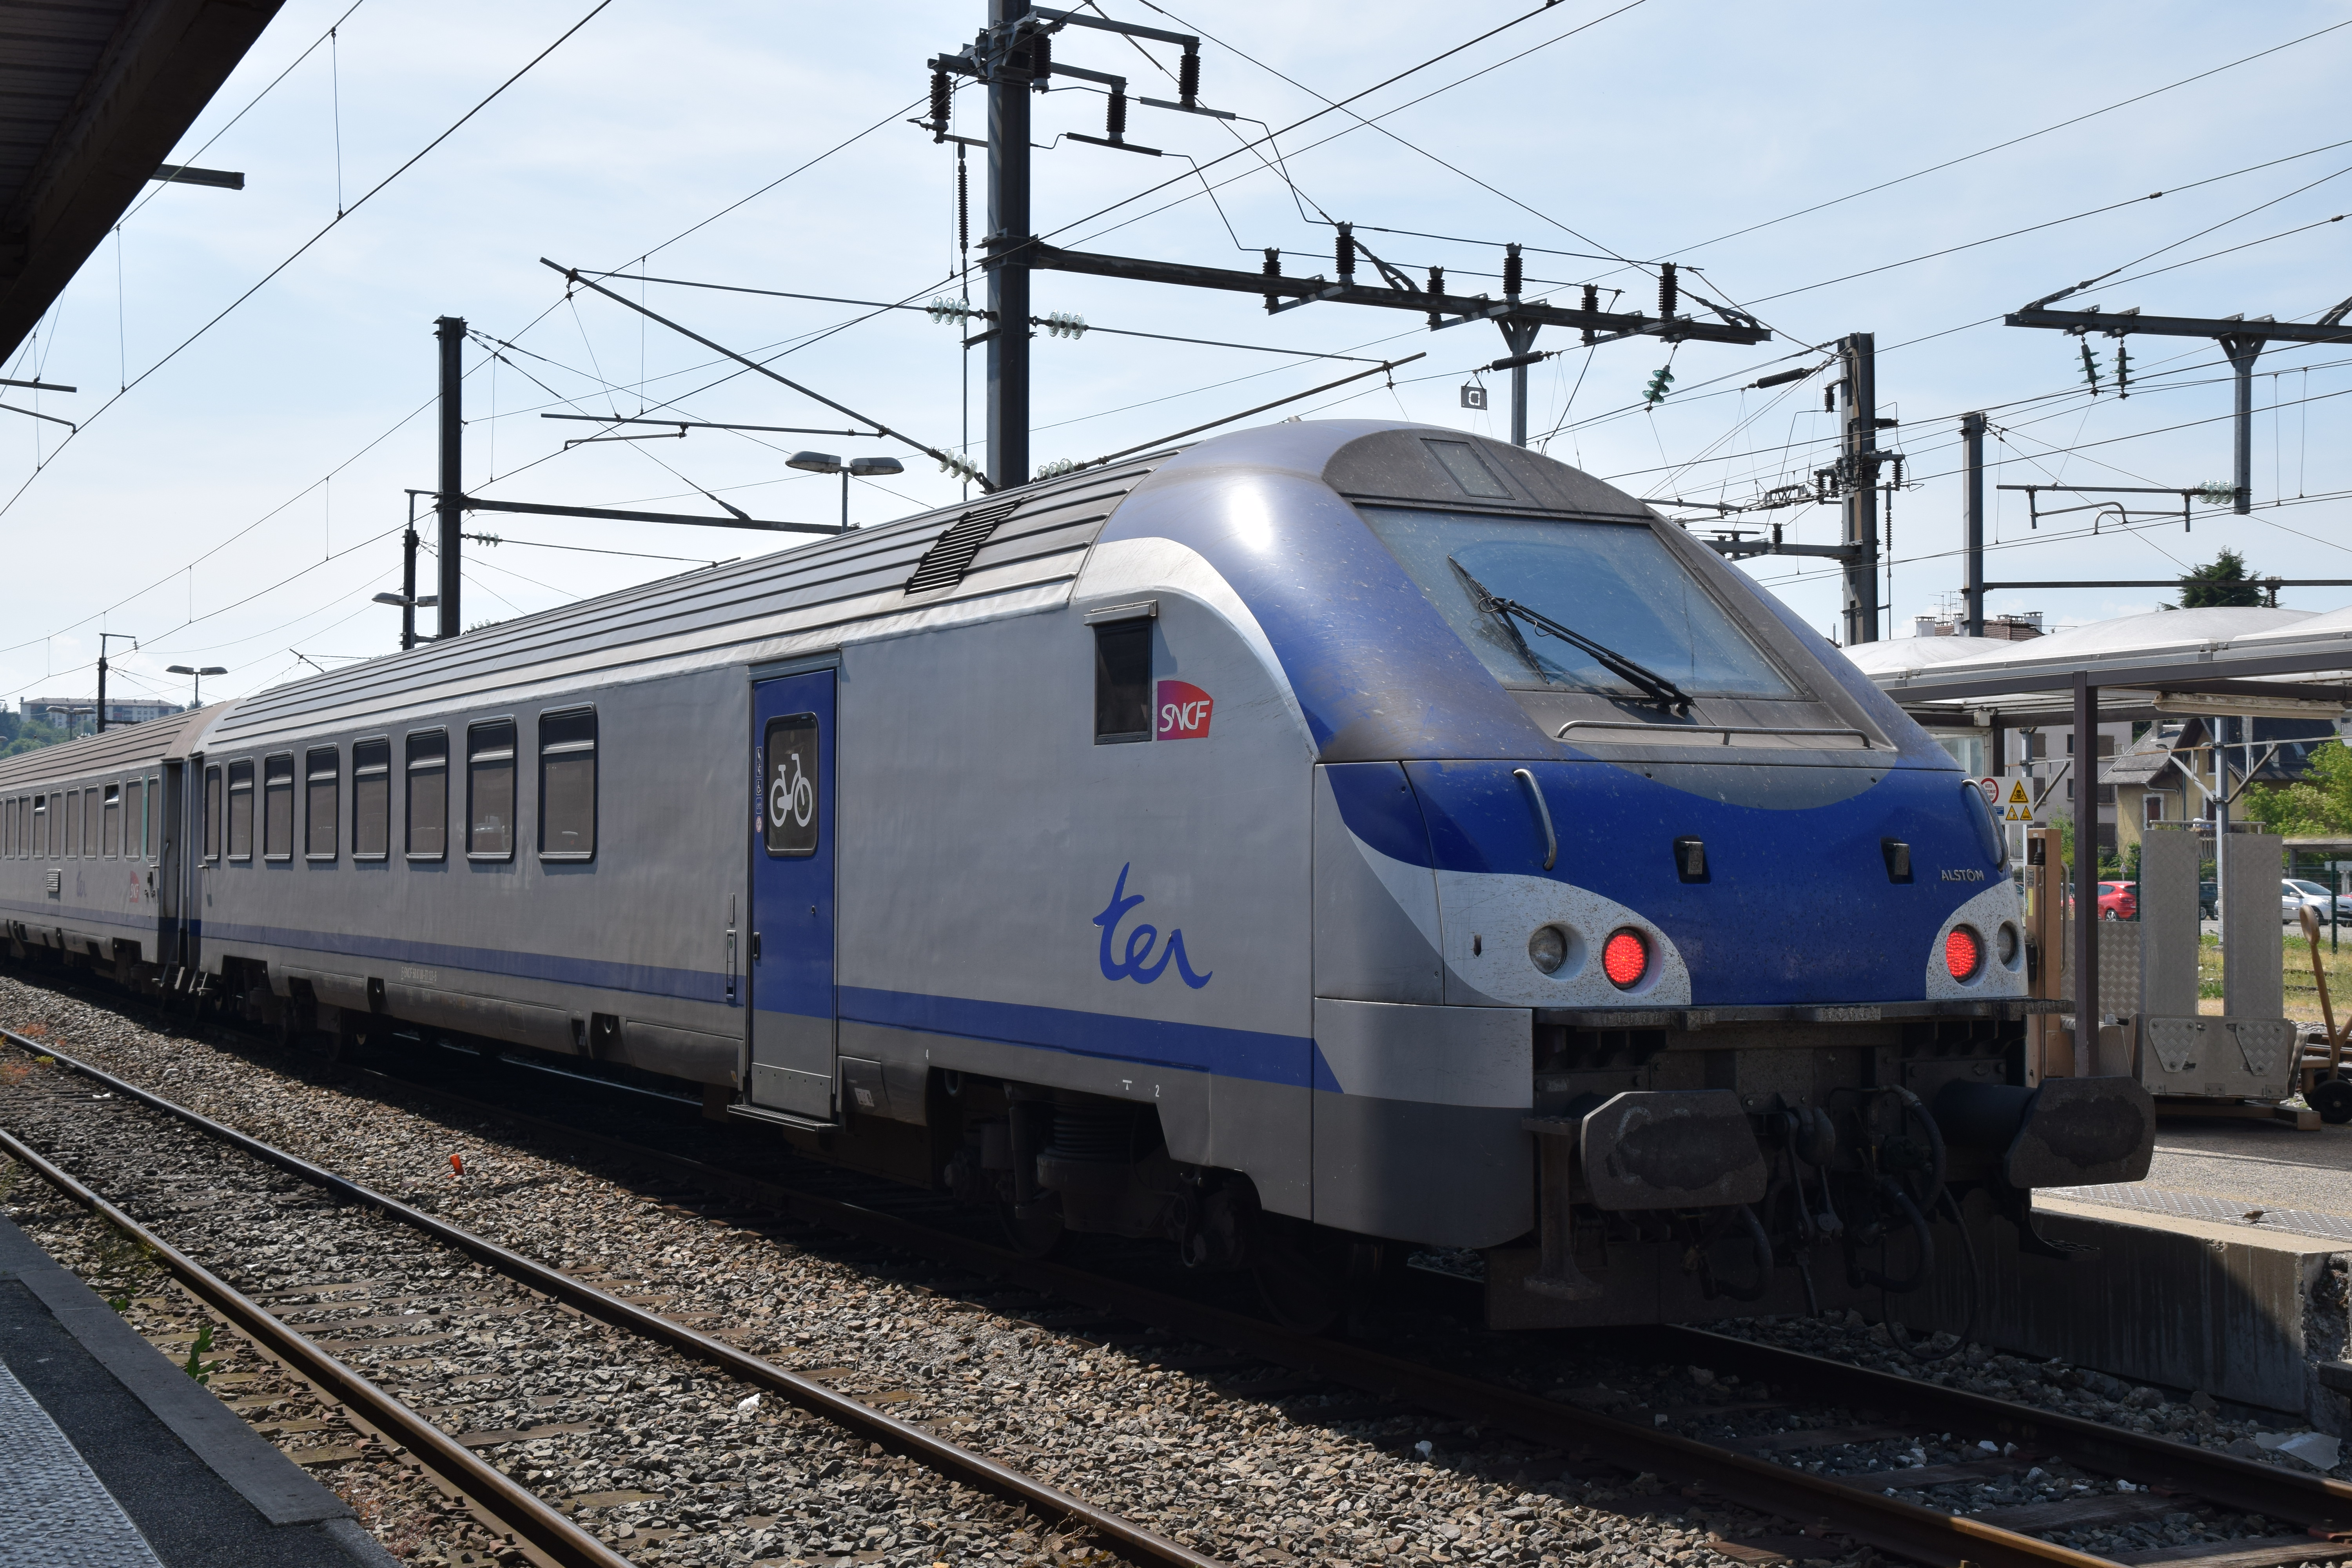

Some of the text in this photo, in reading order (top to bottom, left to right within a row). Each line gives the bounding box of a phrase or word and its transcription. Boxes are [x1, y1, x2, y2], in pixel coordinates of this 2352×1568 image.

[1159, 700, 1210, 732] SNCF
[1941, 869, 1984, 881] ALSTOM
[130, 884, 139, 898] SNCF
[1093, 862, 1213, 989] ter
[926, 1049, 929, 1060] 4
[1155, 1084, 1160, 1098] 2
